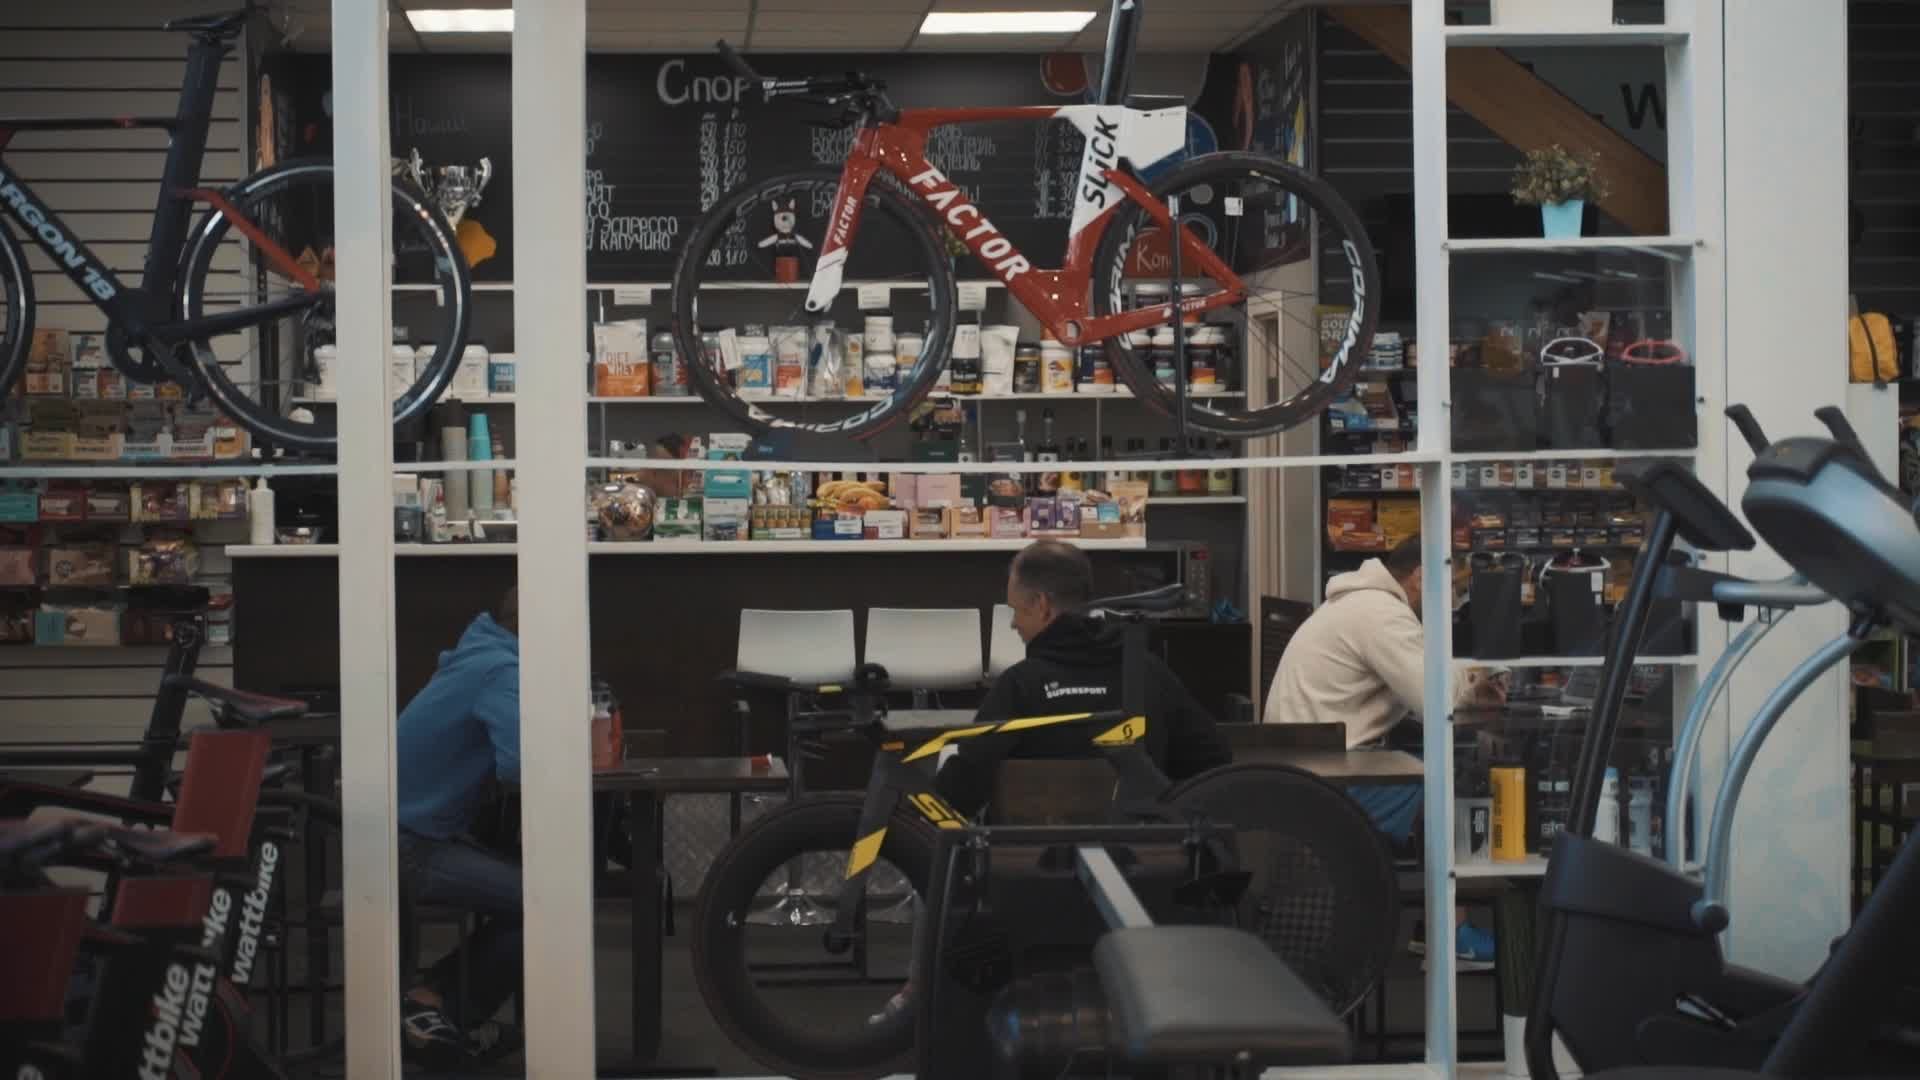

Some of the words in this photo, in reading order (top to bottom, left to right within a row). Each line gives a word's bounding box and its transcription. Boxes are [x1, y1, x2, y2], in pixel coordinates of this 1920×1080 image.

[0, 169, 86, 268] RGON
[83, 266, 117, 300] 18
[832, 196, 858, 245] FACTOR
[909, 159, 1031, 281] FACTOR
[1046, 687, 1107, 699] SUPERSPORT
